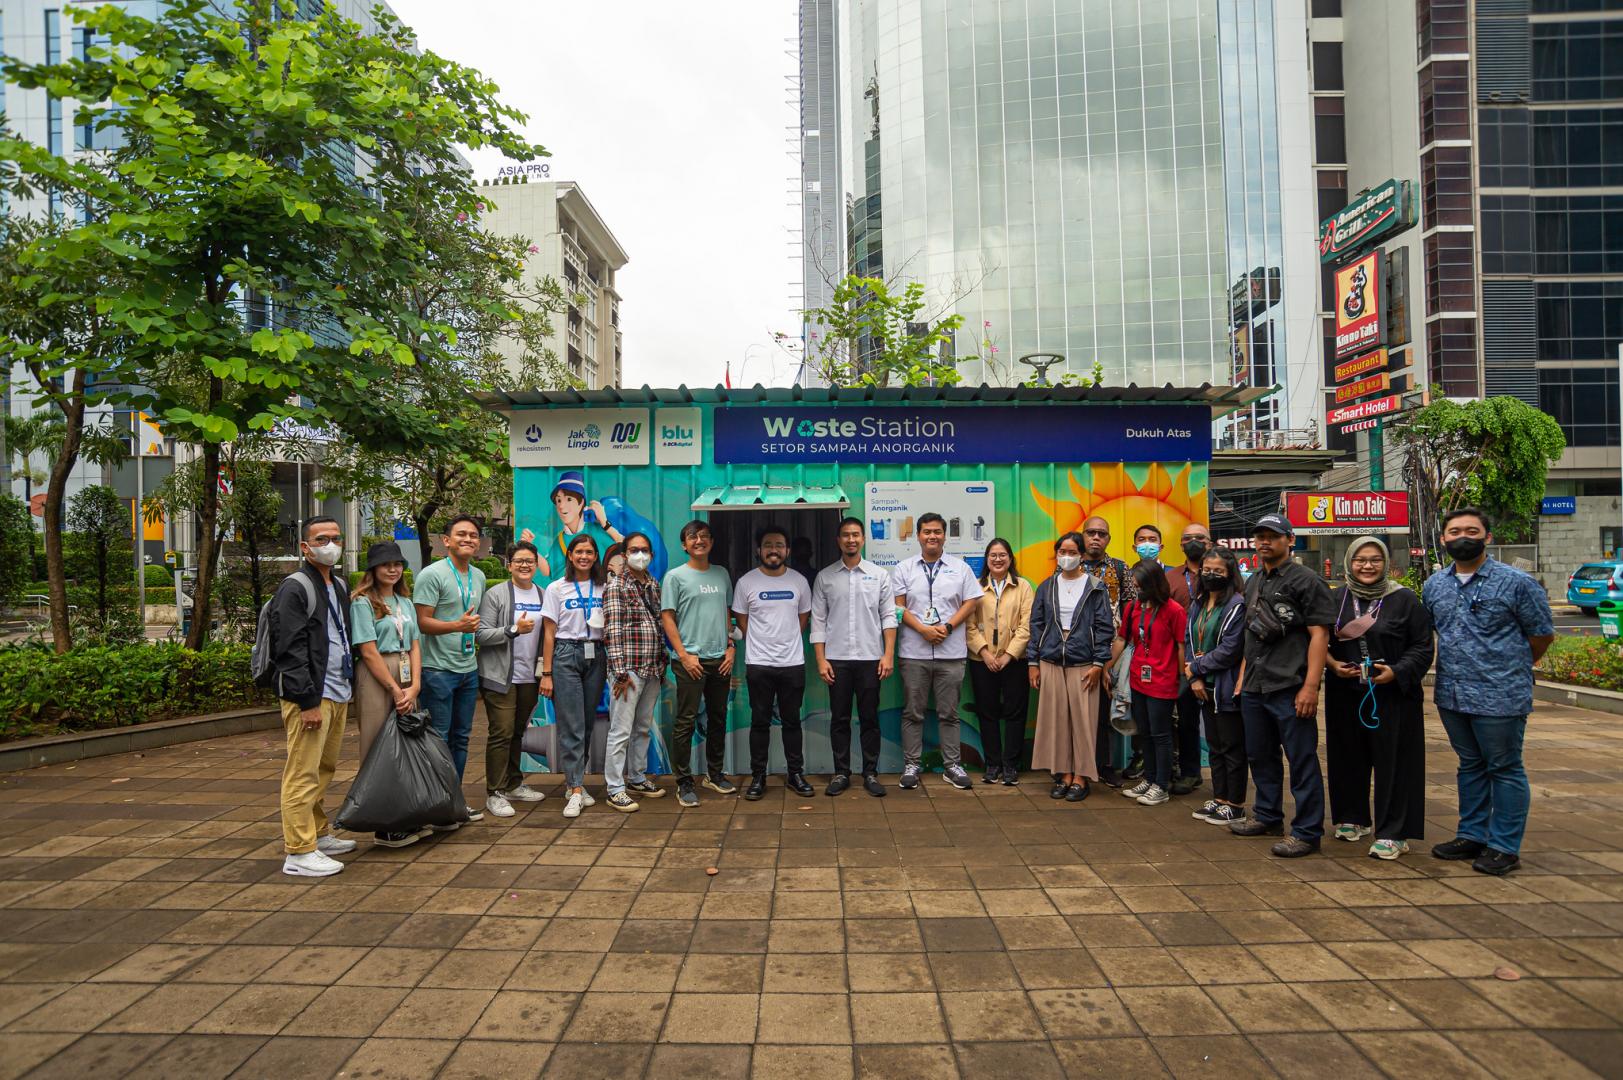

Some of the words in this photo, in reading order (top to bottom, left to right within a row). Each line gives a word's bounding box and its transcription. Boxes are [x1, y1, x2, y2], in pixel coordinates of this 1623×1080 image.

[498, 165, 525, 176] ASIA
[526, 163, 550, 174] PRO
[1336, 186, 1394, 229] American
[1335, 217, 1363, 243] Grill
[1360, 320, 1378, 339] Taki
[1336, 354, 1379, 378] Restaurant
[1331, 406, 1364, 423] Smart
[1365, 398, 1390, 413] Hotel
[662, 425, 693, 439] blu
[860, 415, 955, 437] Station
[568, 430, 584, 439] Jak
[1126, 428, 1164, 438] Dukuh
[1166, 428, 1192, 438] Atas
[567, 439, 600, 450] Lingko
[761, 443, 805, 453] SETOR
[810, 443, 867, 453] SAMPAH
[872, 443, 955, 453] ANORGANIK
[871, 498, 899, 506] Sampah
[1334, 497, 1351, 515] Kin
[1352, 499, 1365, 515] no
[1365, 496, 1386, 515] Taki
[871, 505, 908, 513] Anorganik
[1216, 537, 1256, 549] sma
[871, 552, 895, 560] Minyak
[699, 584, 719, 594] blu
